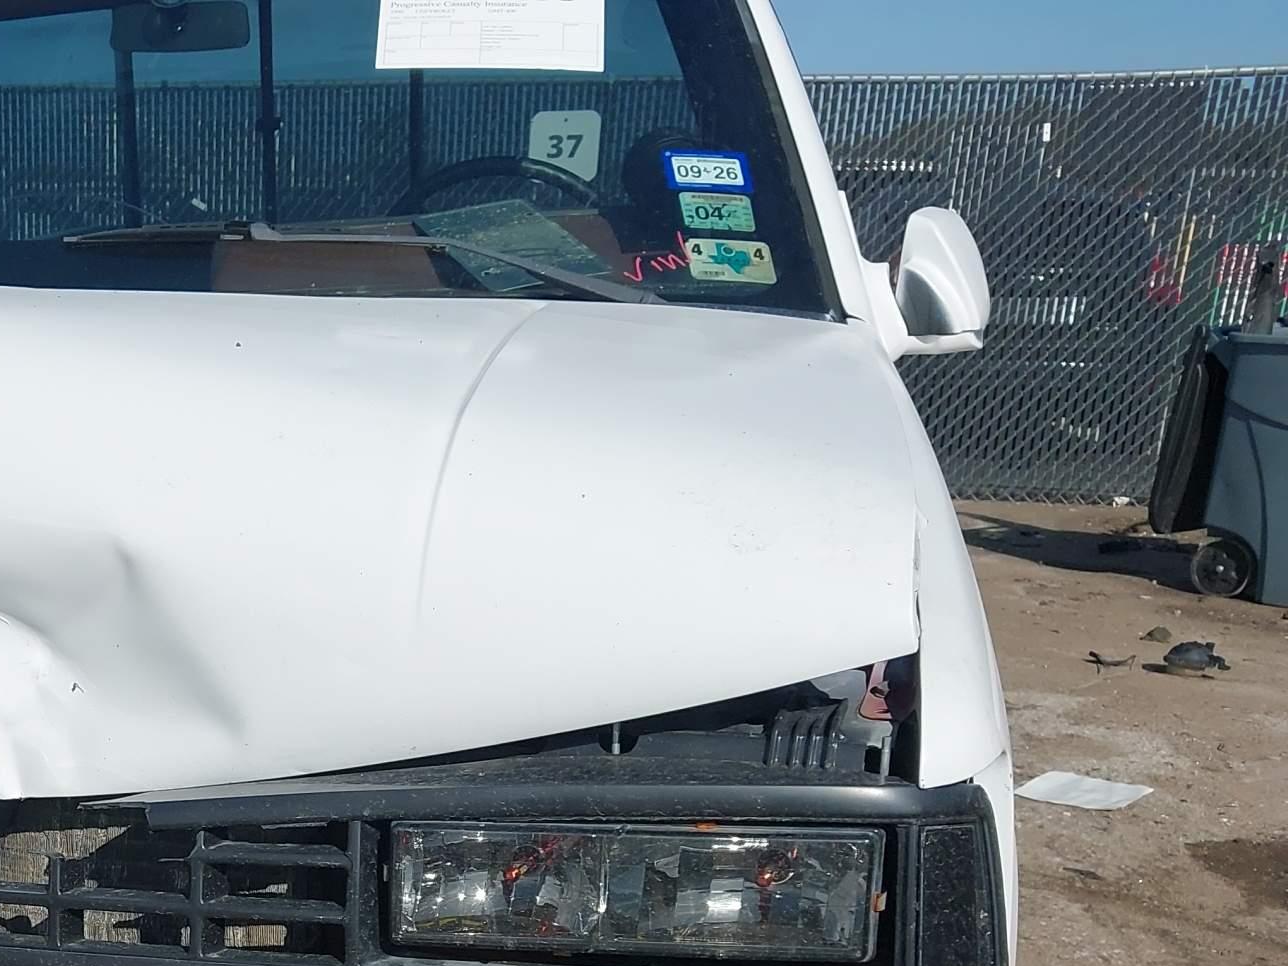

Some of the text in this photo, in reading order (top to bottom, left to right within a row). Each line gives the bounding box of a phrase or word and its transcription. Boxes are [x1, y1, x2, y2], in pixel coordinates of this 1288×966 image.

[443, 0, 481, 8] Casualty
[546, 134, 584, 159] 37
[676, 165, 738, 180] 09 26
[694, 205, 724, 221] 04
[691, 243, 765, 261] 4 4
